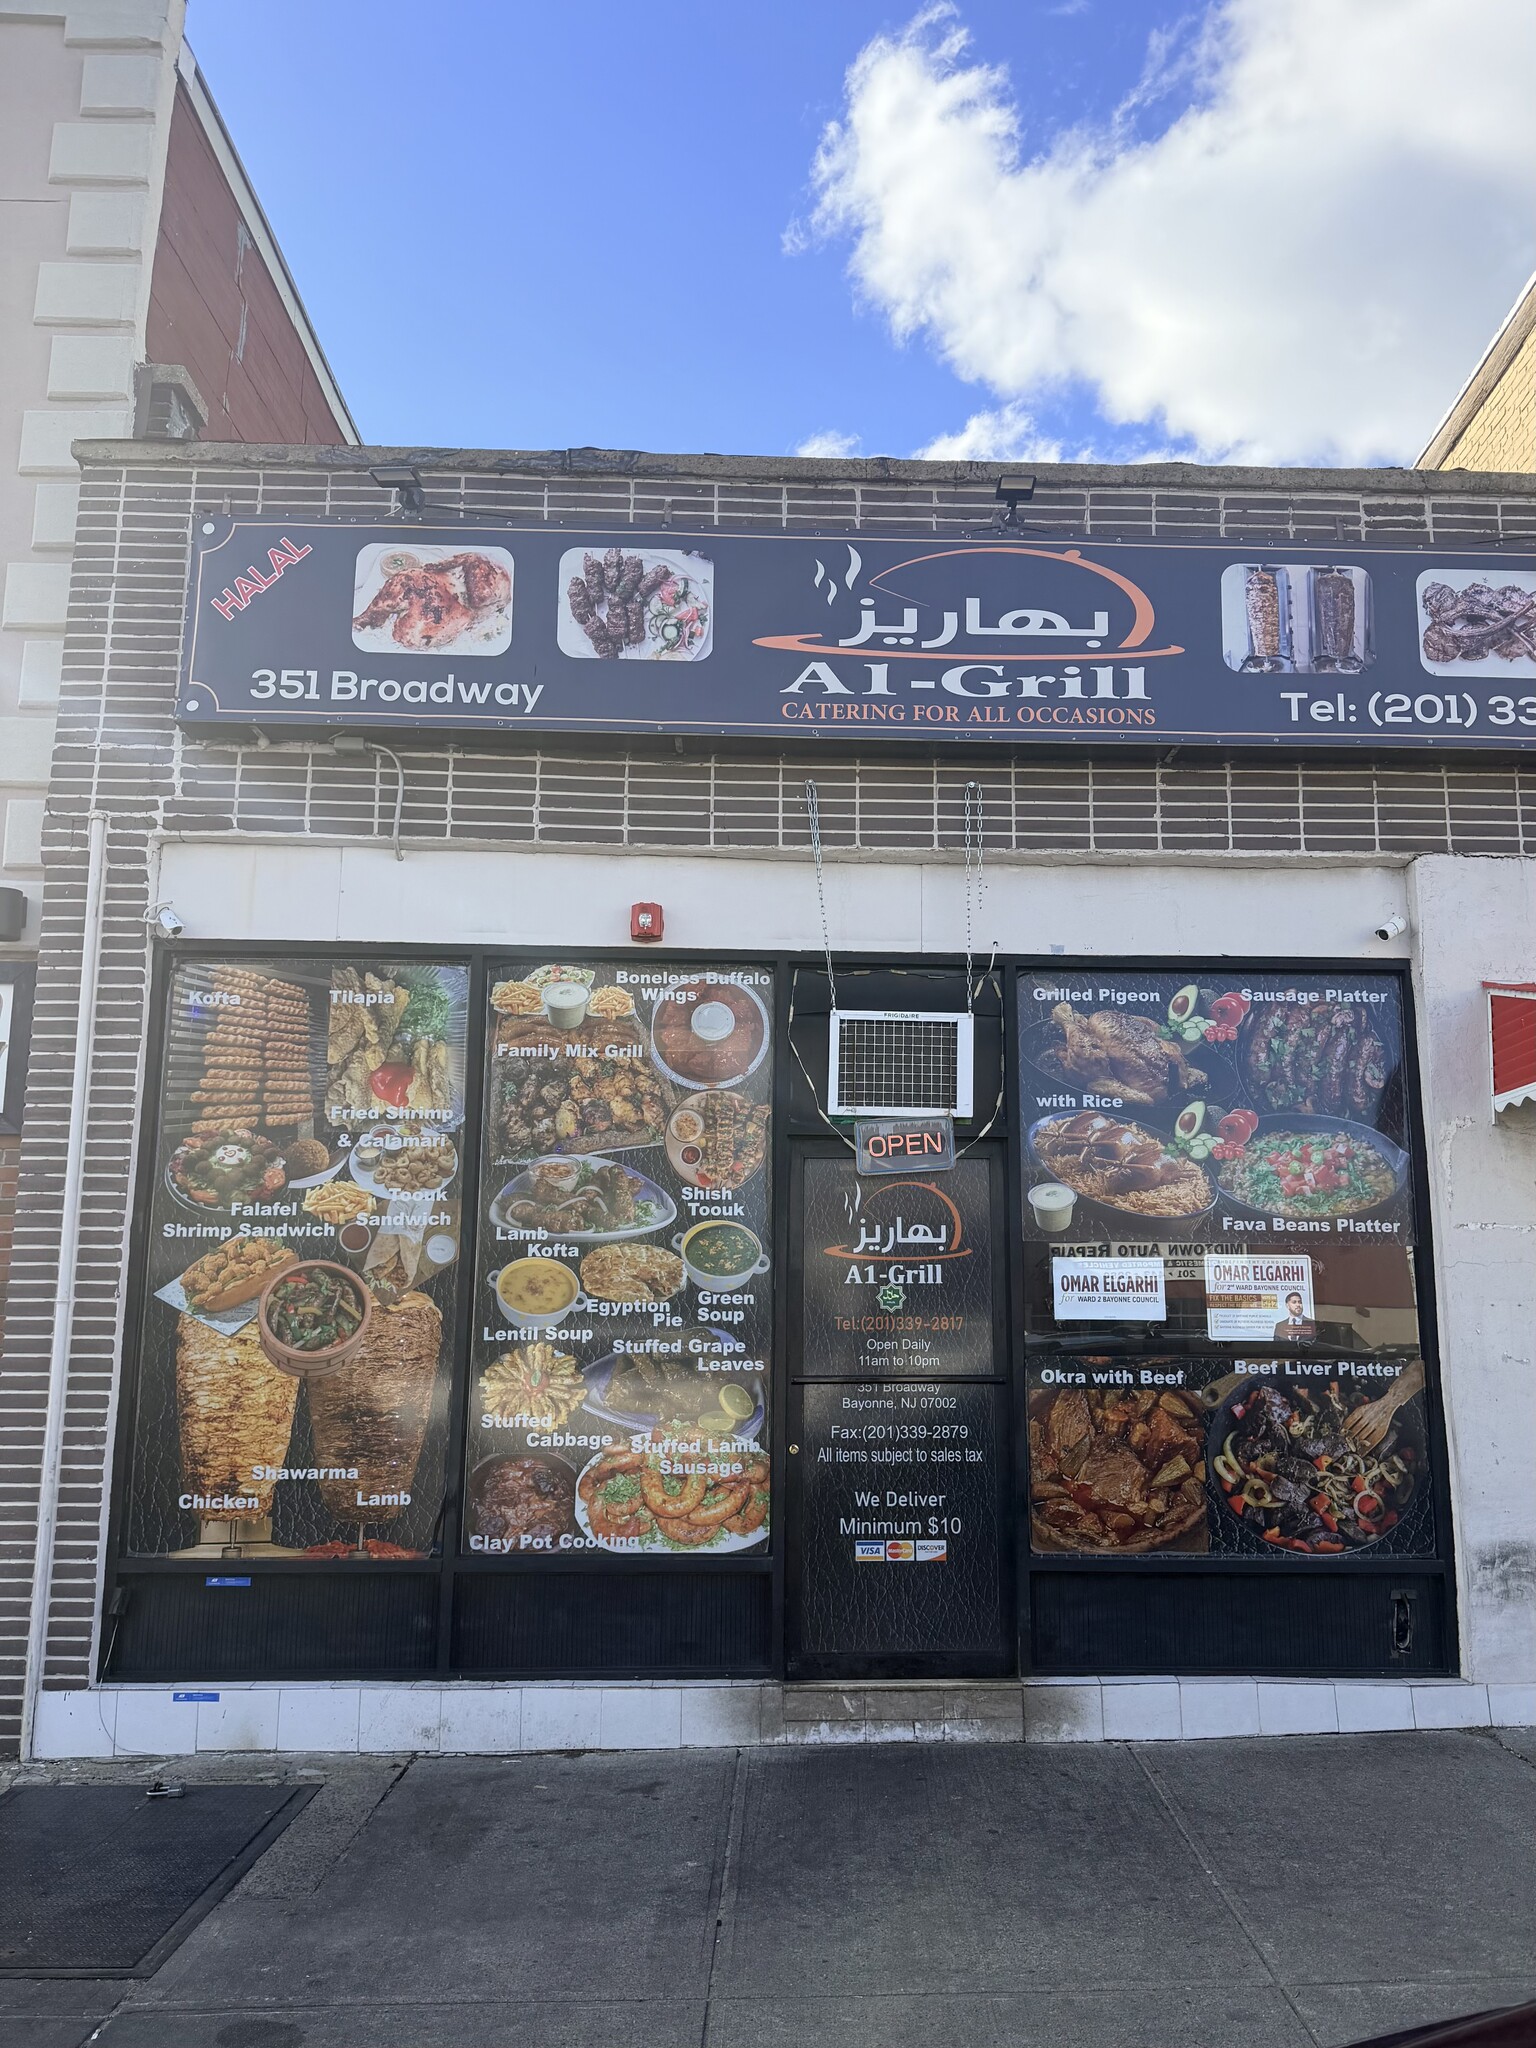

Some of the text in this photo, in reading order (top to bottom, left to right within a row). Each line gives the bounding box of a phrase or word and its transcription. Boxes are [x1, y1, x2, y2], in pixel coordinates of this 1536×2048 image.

[211, 537, 313, 621] HALAL
[250, 669, 545, 714] 351 Broadway
[782, 702, 1156, 725] CATERING FOR ALL OCCASIONS
[1280, 691, 1536, 728] Tel: (201) 33
[616, 971, 770, 985] Boneless Buffalo
[190, 991, 240, 1006] Kofta
[330, 990, 394, 1005] Tilapia
[642, 988, 697, 1004] Wings
[1033, 988, 1161, 1005] Grilled Pigeon
[1241, 989, 1388, 1005] Sausage Platter
[498, 1044, 643, 1060] Family Mix Grill
[1036, 1095, 1123, 1108] with Rice
[331, 1106, 454, 1123] Fried Shrimp
[337, 1133, 446, 1148] & Calamari
[868, 1132, 942, 1157] OPEN
[389, 1188, 448, 1202] Toouk
[682, 1186, 732, 1200] Shish
[231, 1202, 297, 1216] Falafel
[688, 1203, 744, 1216] Toouk
[356, 1211, 451, 1227] Sandwich
[1223, 1217, 1400, 1234] Fava Beans Platter
[163, 1223, 335, 1240] Shrimp Sandwich
[496, 1227, 549, 1241] Lamb
[528, 1244, 579, 1258] Kofta
[1214, 1265, 1304, 1281] OMAR ELGARHI
[1061, 1275, 1158, 1293] OMAR ELGARHI
[698, 1291, 754, 1306] Green
[1059, 1293, 1075, 1305] for
[586, 1299, 670, 1316] Egyption
[653, 1313, 682, 1327] Pie
[698, 1308, 744, 1324] Soup
[484, 1328, 593, 1343] Lentil Soup
[612, 1340, 746, 1356] Stuffed Grape
[867, 1339, 931, 1351] Open Daily
[698, 1358, 764, 1371] Leaves
[859, 1355, 940, 1367] 11am to 10pm
[1234, 1360, 1403, 1378] Beef Liver Platter
[1041, 1369, 1184, 1385] Okra with Beef
[842, 1398, 956, 1411] Bayonne, NJ 07002
[481, 1414, 552, 1428] Stuffed
[526, 1433, 613, 1450] Cabbage
[631, 1440, 760, 1454] Stuffed Lamb
[817, 1448, 983, 1465] All items subject to sales tax
[252, 1465, 359, 1480] Shawarma
[660, 1460, 743, 1476] Sausage
[178, 1494, 259, 1509] Chicken
[356, 1491, 411, 1506] Lamb
[855, 1491, 946, 1507] We Deliver
[840, 1516, 961, 1535] Minimum $10
[470, 1534, 639, 1553] Clay Pot Cooking
[861, 1547, 880, 1555] VISA
